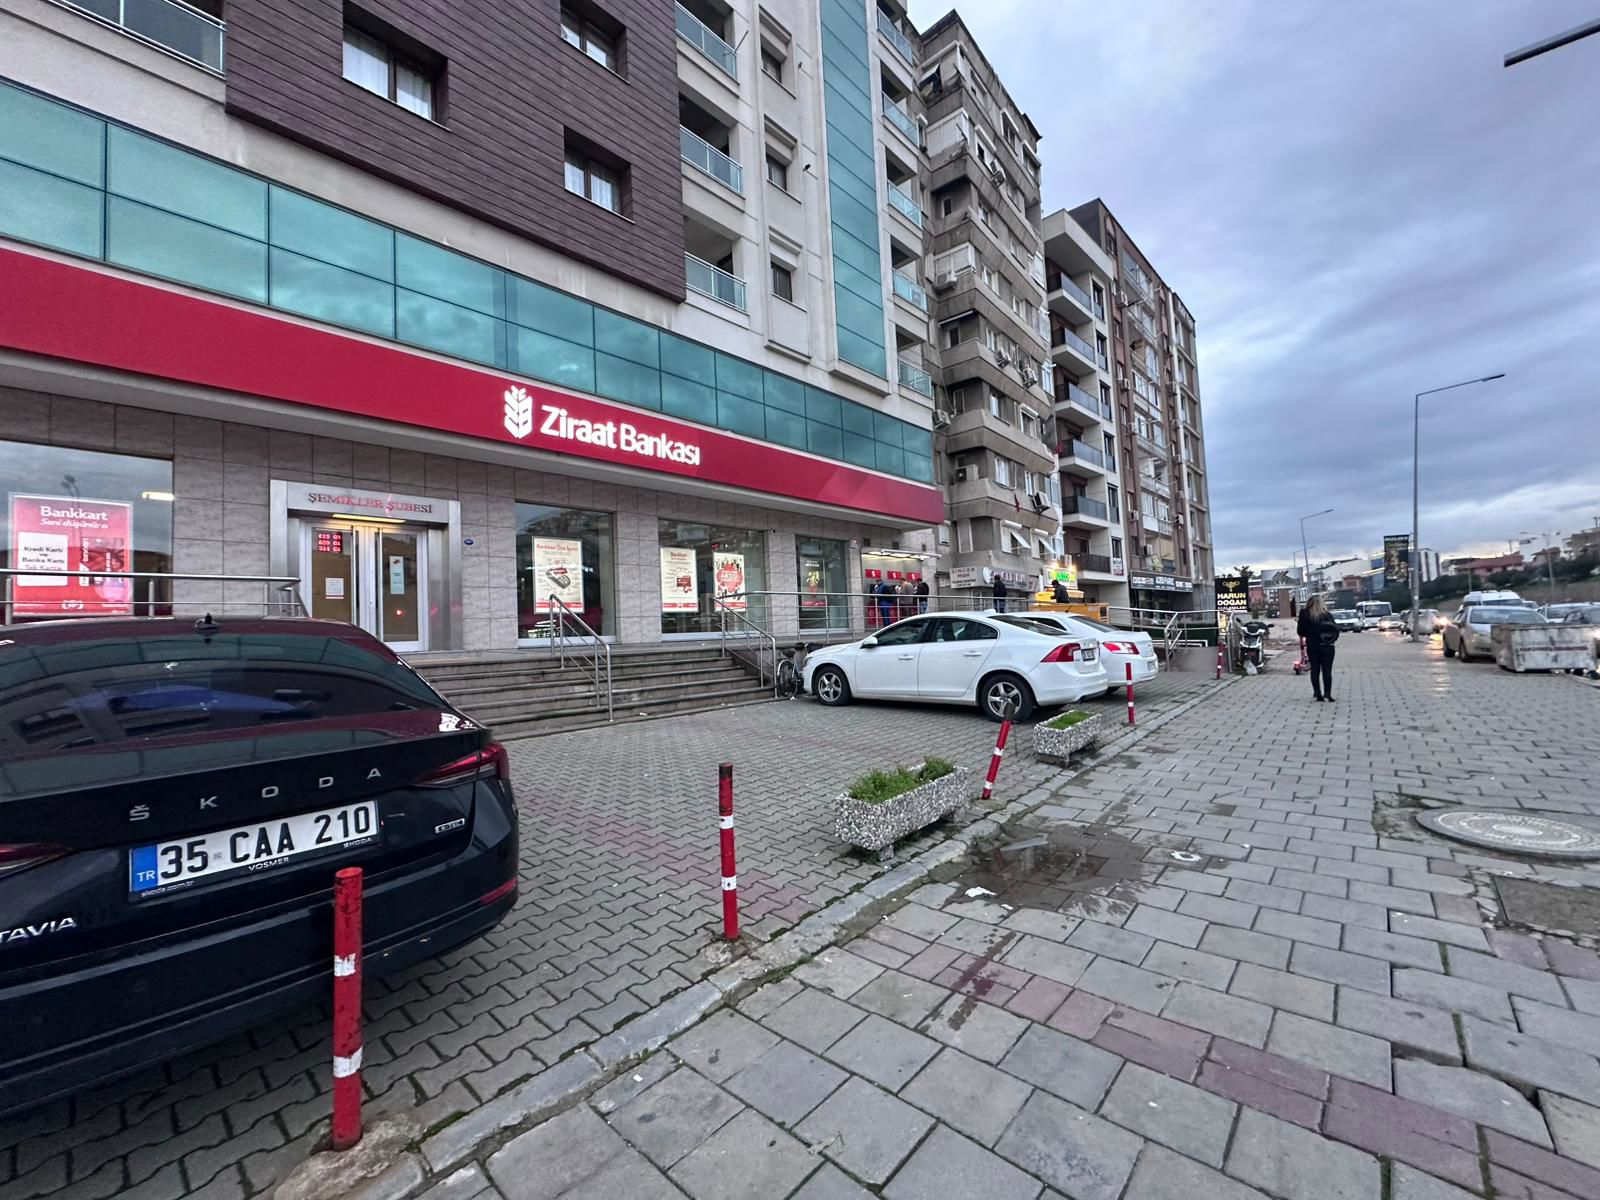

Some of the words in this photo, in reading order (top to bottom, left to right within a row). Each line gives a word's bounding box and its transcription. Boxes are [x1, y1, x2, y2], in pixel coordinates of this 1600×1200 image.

[540, 405, 617, 449] Ziraat
[619, 423, 700, 465] Bankası
[40, 505, 109, 520] Bankkart
[40, 518, 61, 527] Seni
[46, 557, 65, 565] Kartı
[1217, 592, 1246, 600] HARUN
[136, 869, 156, 883] TR
[160, 839, 209, 879] 35
[229, 822, 295, 864] CAA
[314, 806, 370, 845] 210
[248, 856, 290, 871] VOSMER
